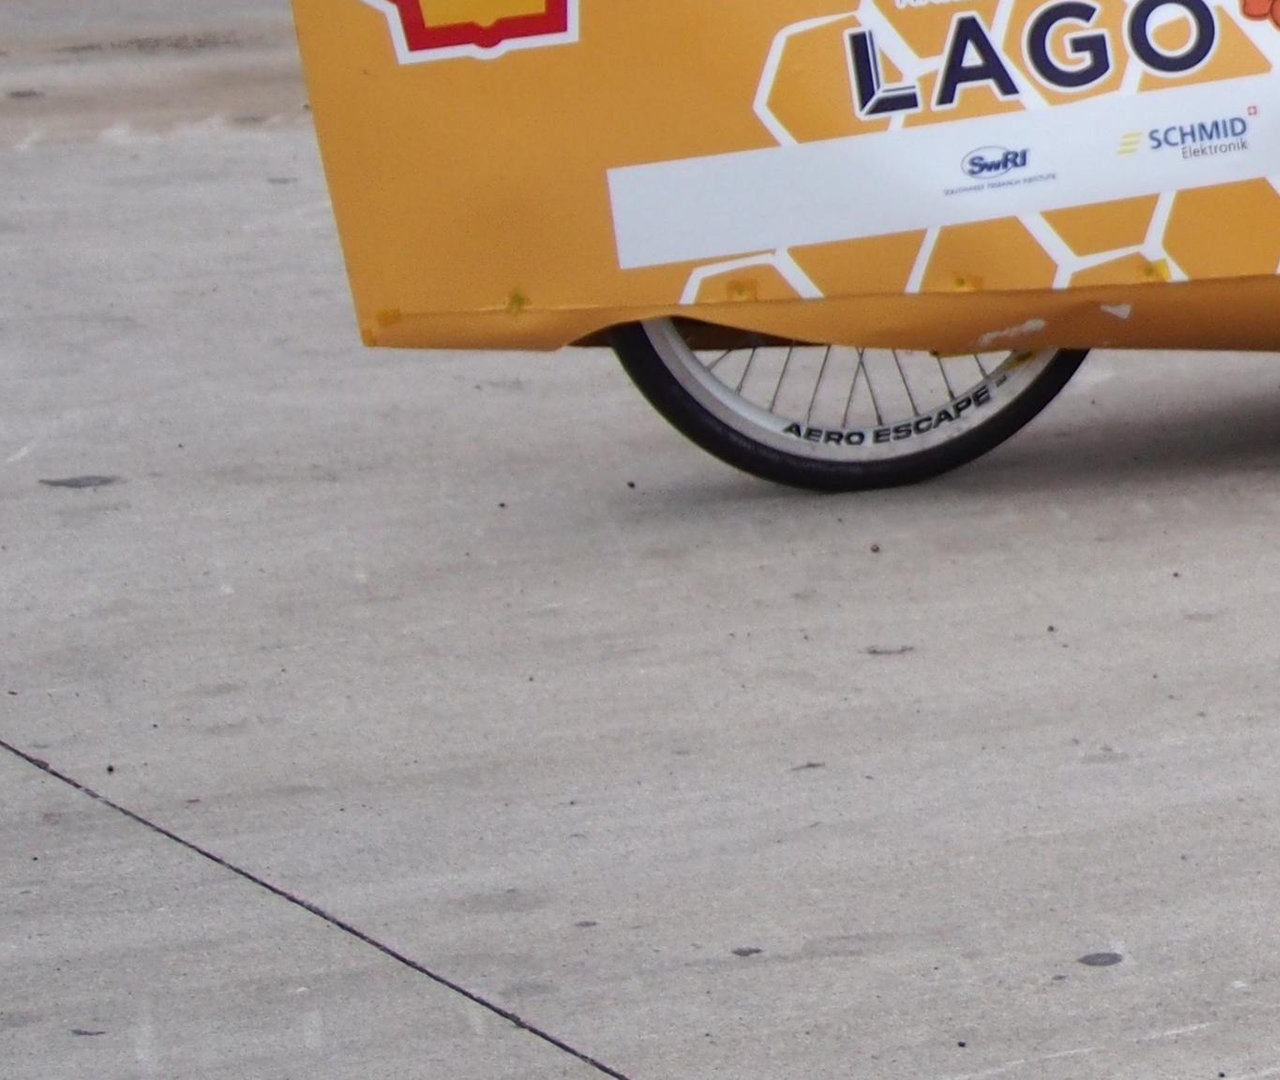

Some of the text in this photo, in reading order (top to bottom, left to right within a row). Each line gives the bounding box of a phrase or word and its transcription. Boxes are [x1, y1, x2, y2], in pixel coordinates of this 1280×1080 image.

[1149, 116, 1248, 150] SCHMID
[1181, 138, 1249, 160] Elektronik
[783, 388, 992, 446] AERO ESCAPE
